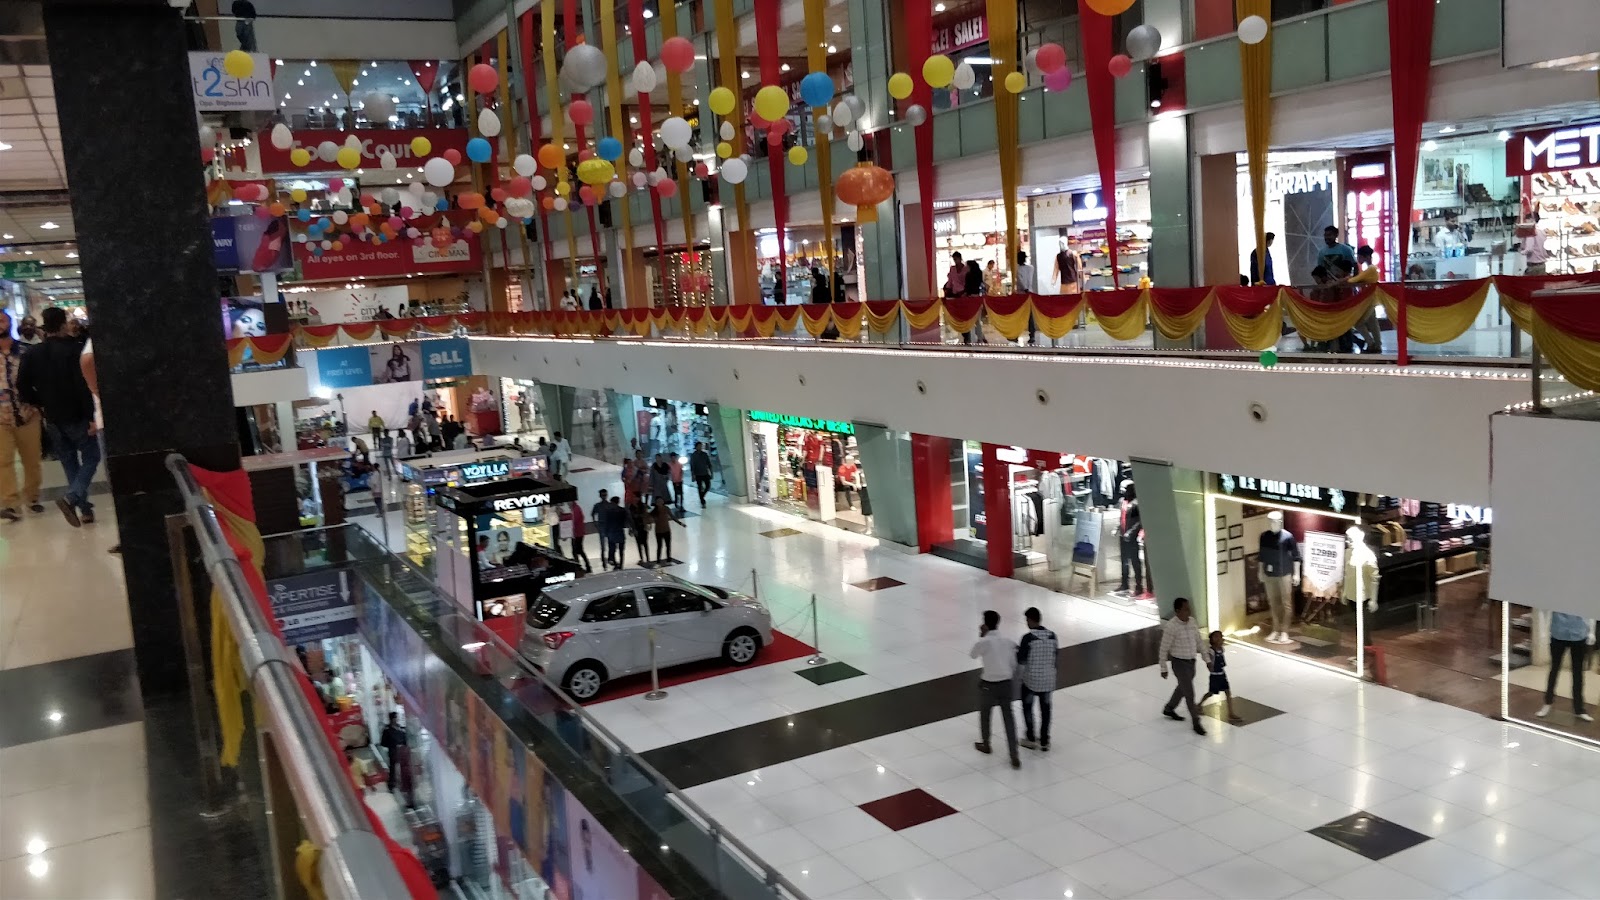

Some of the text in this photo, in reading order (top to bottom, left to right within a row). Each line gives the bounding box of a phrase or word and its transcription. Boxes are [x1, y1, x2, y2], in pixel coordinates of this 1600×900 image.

[954, 16, 983, 46] SALE!
[361, 138, 412, 159] Cour
[1523, 125, 1600, 171] MET
[308, 251, 400, 265] All eyes on 3rd floor.
[463, 462, 509, 477] VOYLLA
[1260, 479, 1288, 496] POLO
[494, 494, 551, 511] REVLON
